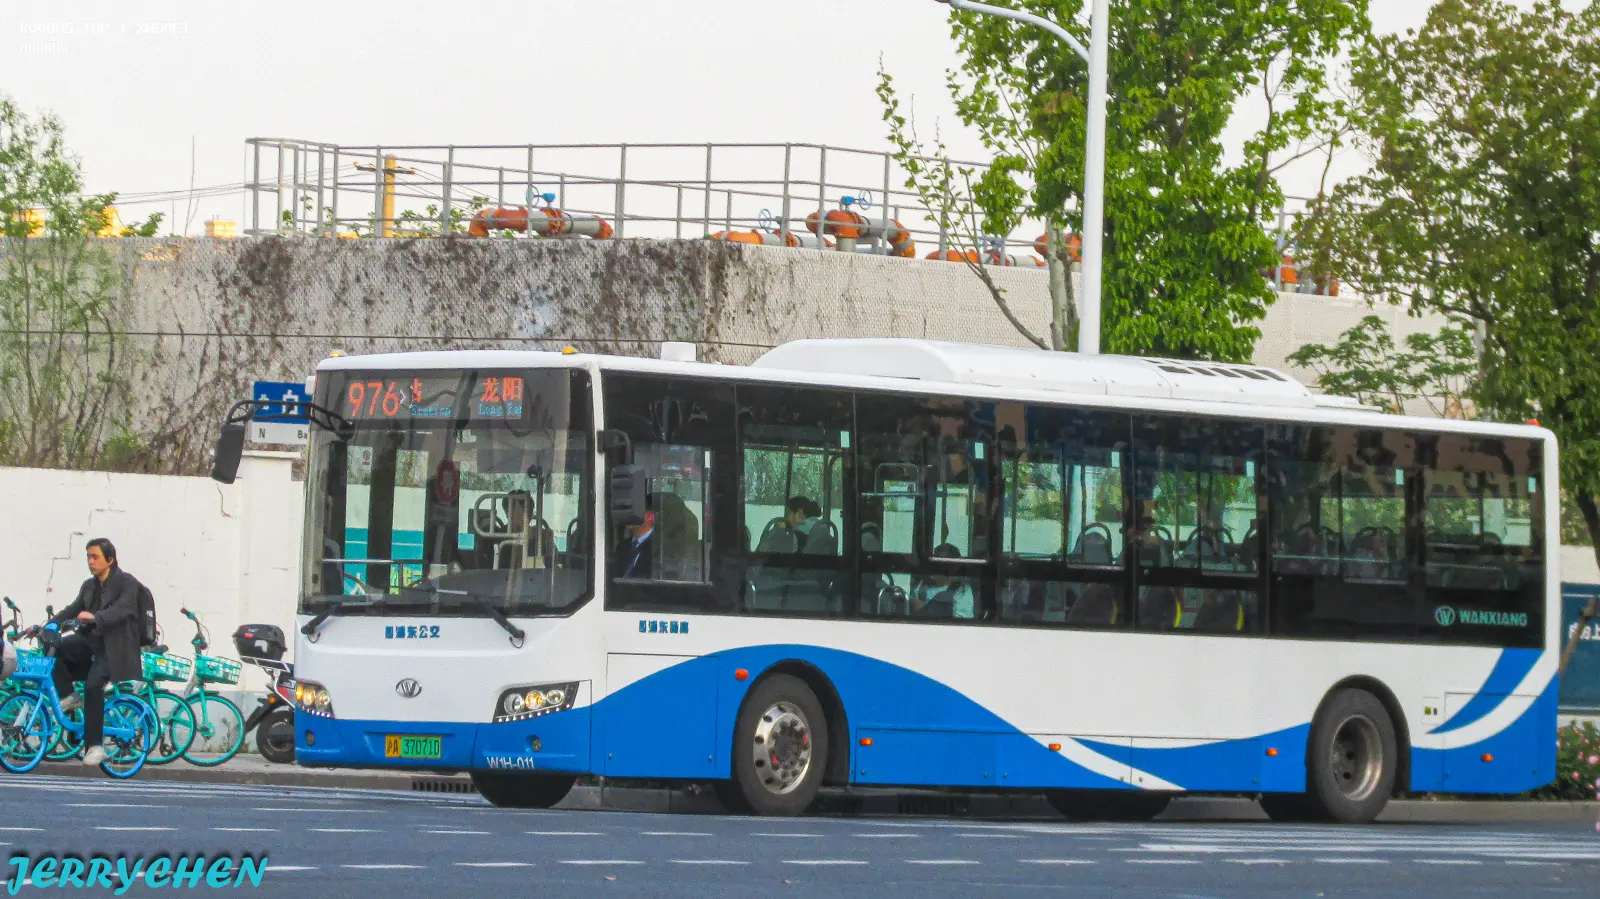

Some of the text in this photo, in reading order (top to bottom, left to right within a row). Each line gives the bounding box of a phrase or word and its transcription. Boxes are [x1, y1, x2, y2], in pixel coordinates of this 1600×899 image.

[480, 376, 524, 402] 龙阳
[348, 381, 400, 417] 976
[258, 427, 267, 439] N
[1458, 609, 1529, 627] WANXIANG
[486, 755, 536, 770] W1H-011
